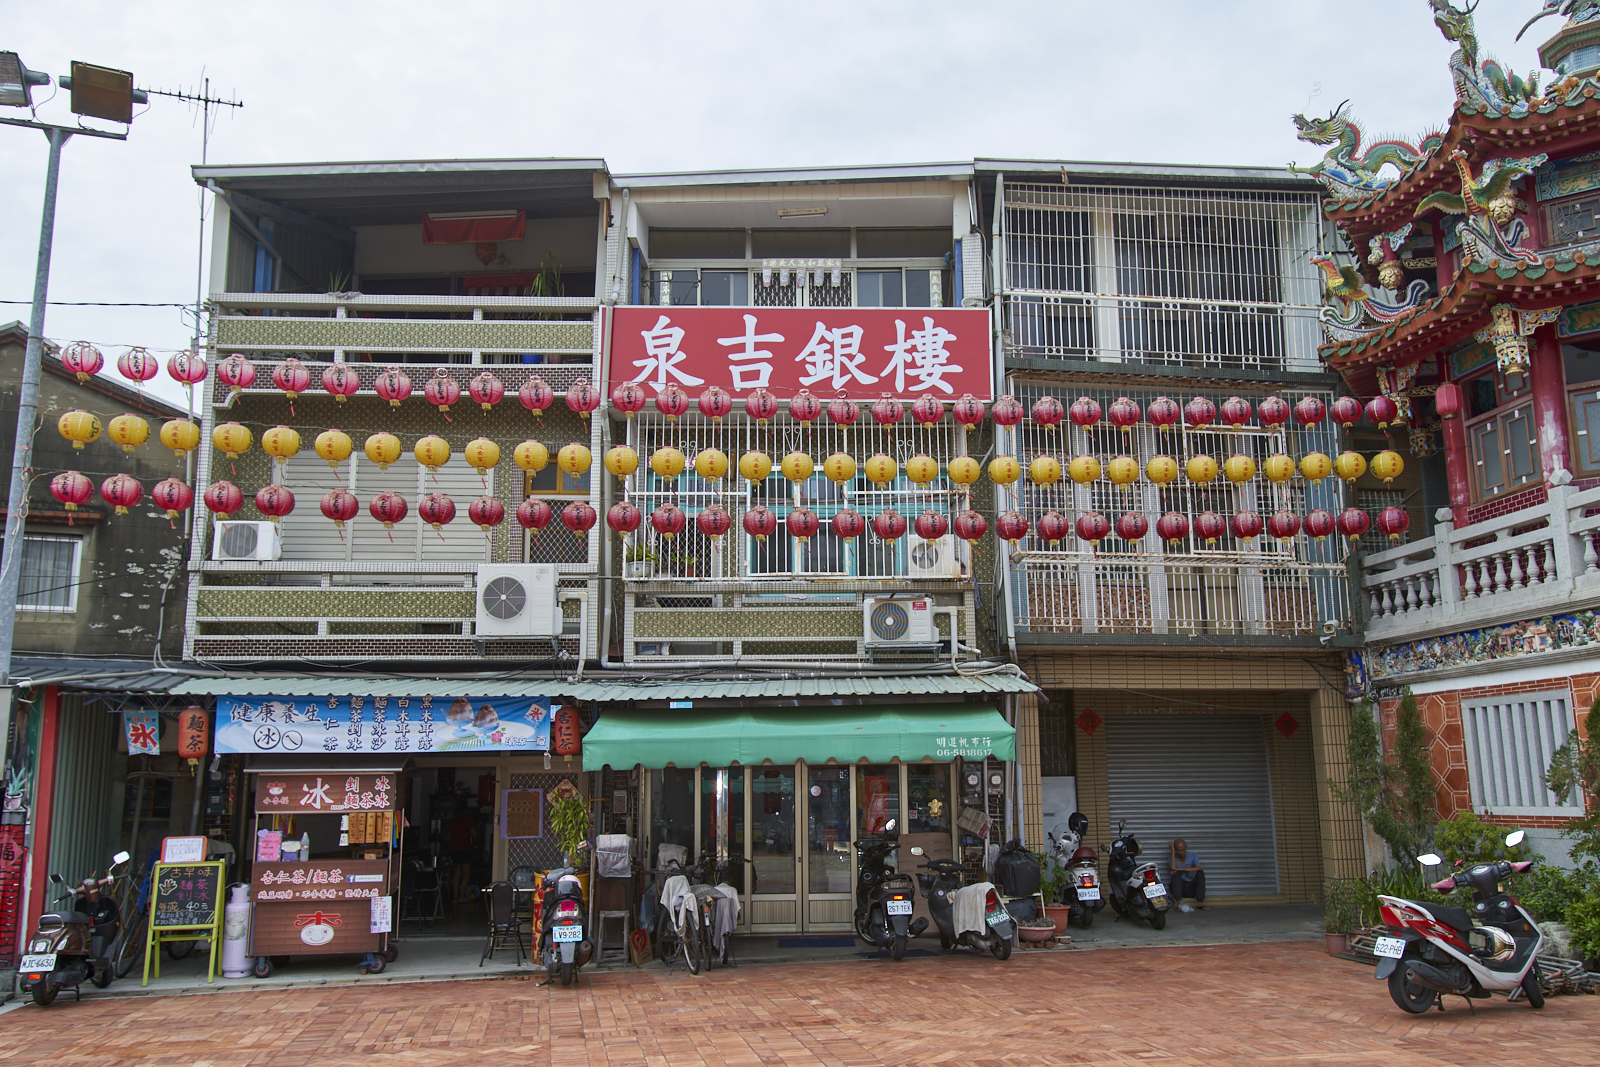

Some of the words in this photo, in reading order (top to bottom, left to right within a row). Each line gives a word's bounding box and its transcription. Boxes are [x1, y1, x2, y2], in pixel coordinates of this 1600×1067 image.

[632, 314, 964, 394] 泉吉銀樓
[230, 702, 322, 724] 健康養生
[323, 696, 340, 751] 杏仁茶
[371, 696, 388, 750] 麵茶冰沙
[395, 696, 410, 750] 白木耳露
[418, 696, 434, 750] 黑木耳露
[186, 714, 204, 752] 麵茶
[558, 712, 574, 750] 杏仁茶
[300, 777, 334, 809] 冰
[344, 792, 390, 809] 麵茶冰
[170, 866, 213, 878] 古早味
[260, 868, 344, 884] 杏仁茶/麵茶
[888, 902, 911, 913] 267-TEX
[1376, 943, 1402, 955] 622-PHB
